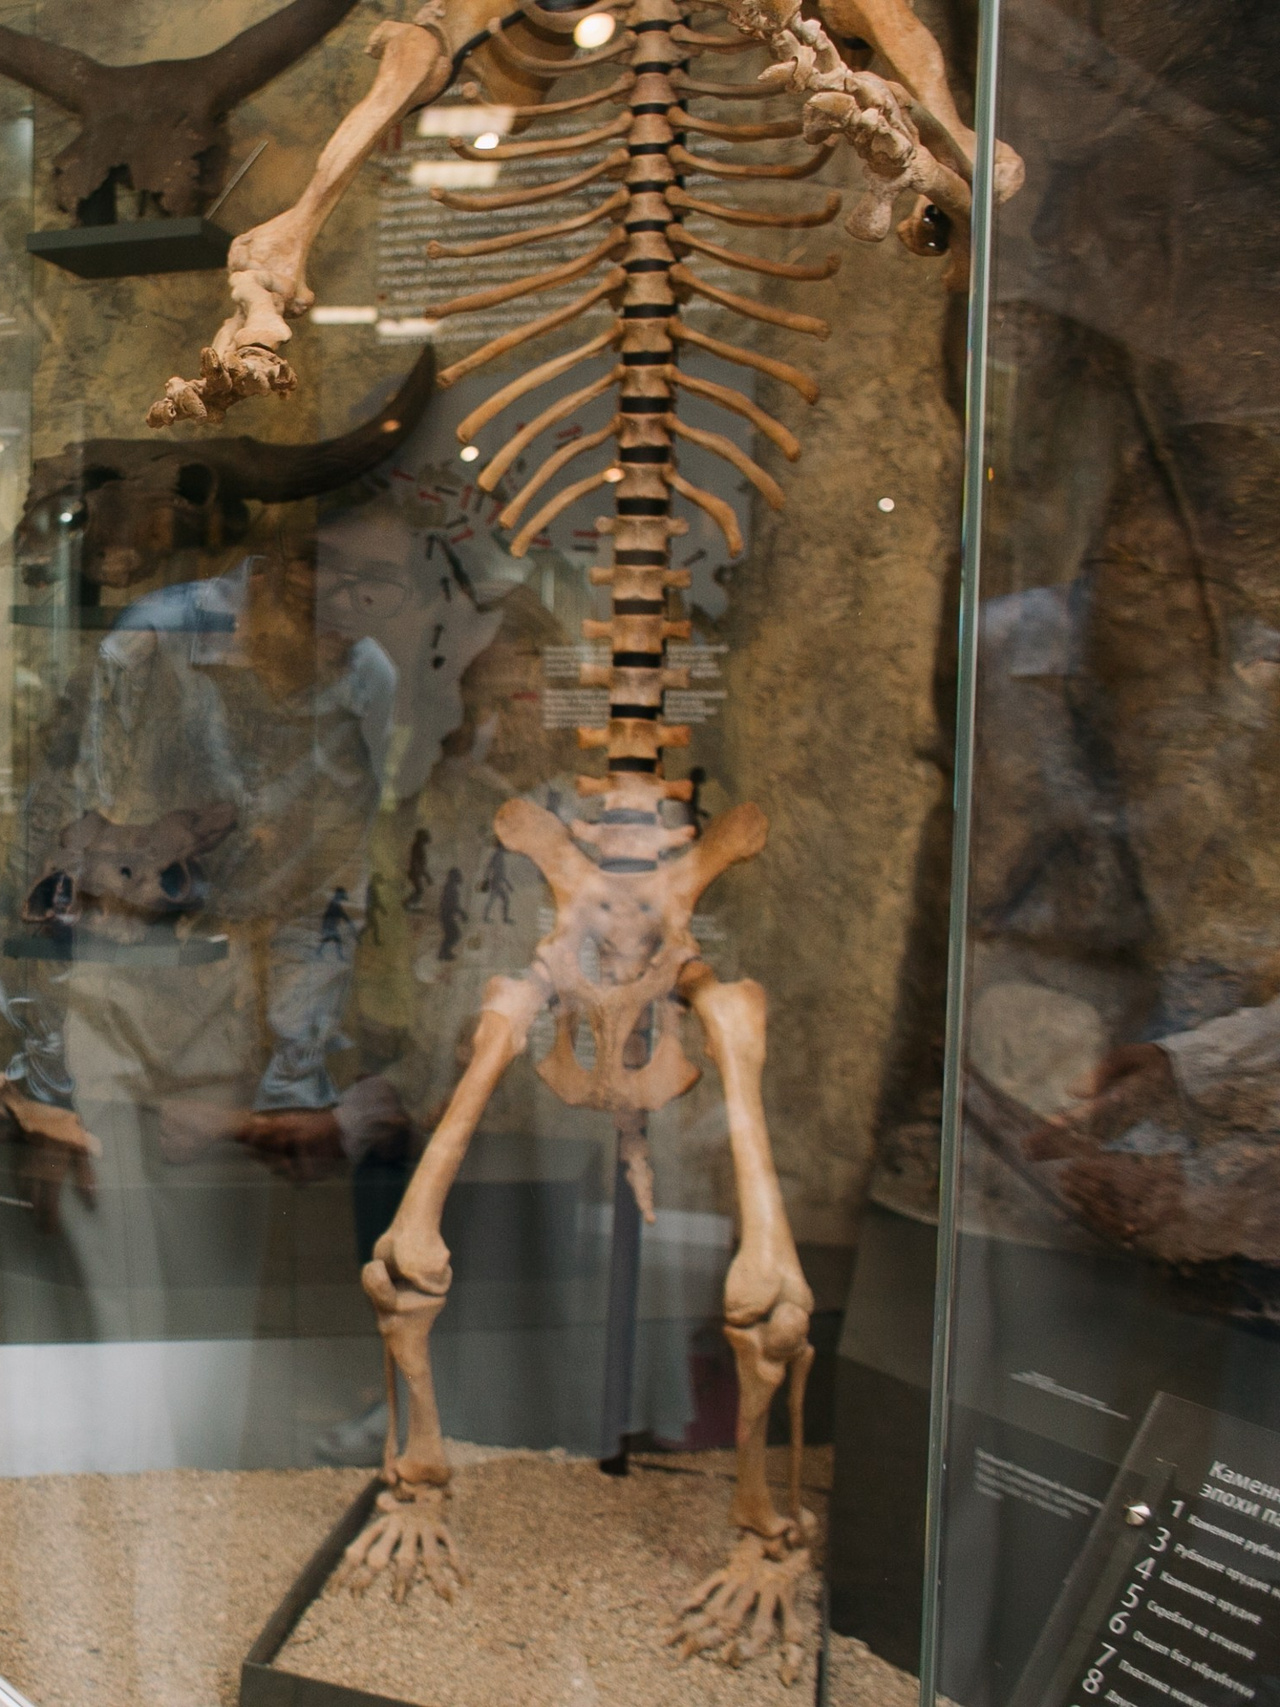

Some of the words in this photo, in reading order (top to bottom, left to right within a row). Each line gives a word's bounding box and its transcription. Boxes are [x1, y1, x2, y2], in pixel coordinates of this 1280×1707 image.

[1171, 1499, 1185, 1519] 1
[1187, 1513, 1246, 1546] Каменное
[1199, 1482, 1261, 1518] эпохи
[1148, 1526, 1171, 1552] 3
[1173, 1543, 1226, 1573] Рубящее
[1225, 1567, 1272, 1594] орудие
[1134, 1557, 1156, 1580] 4
[1160, 1570, 1216, 1604] Каменное
[1216, 1599, 1262, 1625] орудие
[1121, 1583, 1145, 1608] 5
[1147, 1599, 1194, 1630] Скребло
[1193, 1624, 1210, 1638] на
[1209, 1632, 1257, 1660] отщепе
[1082, 1668, 1105, 1694] 8
[1094, 1641, 1118, 1667] 7
[1118, 1659, 1171, 1694] Пластина
[1109, 1611, 1131, 1635] 6
[1133, 1630, 1171, 1656] Отщеп
[1170, 1648, 1192, 1667] без
[1191, 1661, 1256, 1699] обработки
